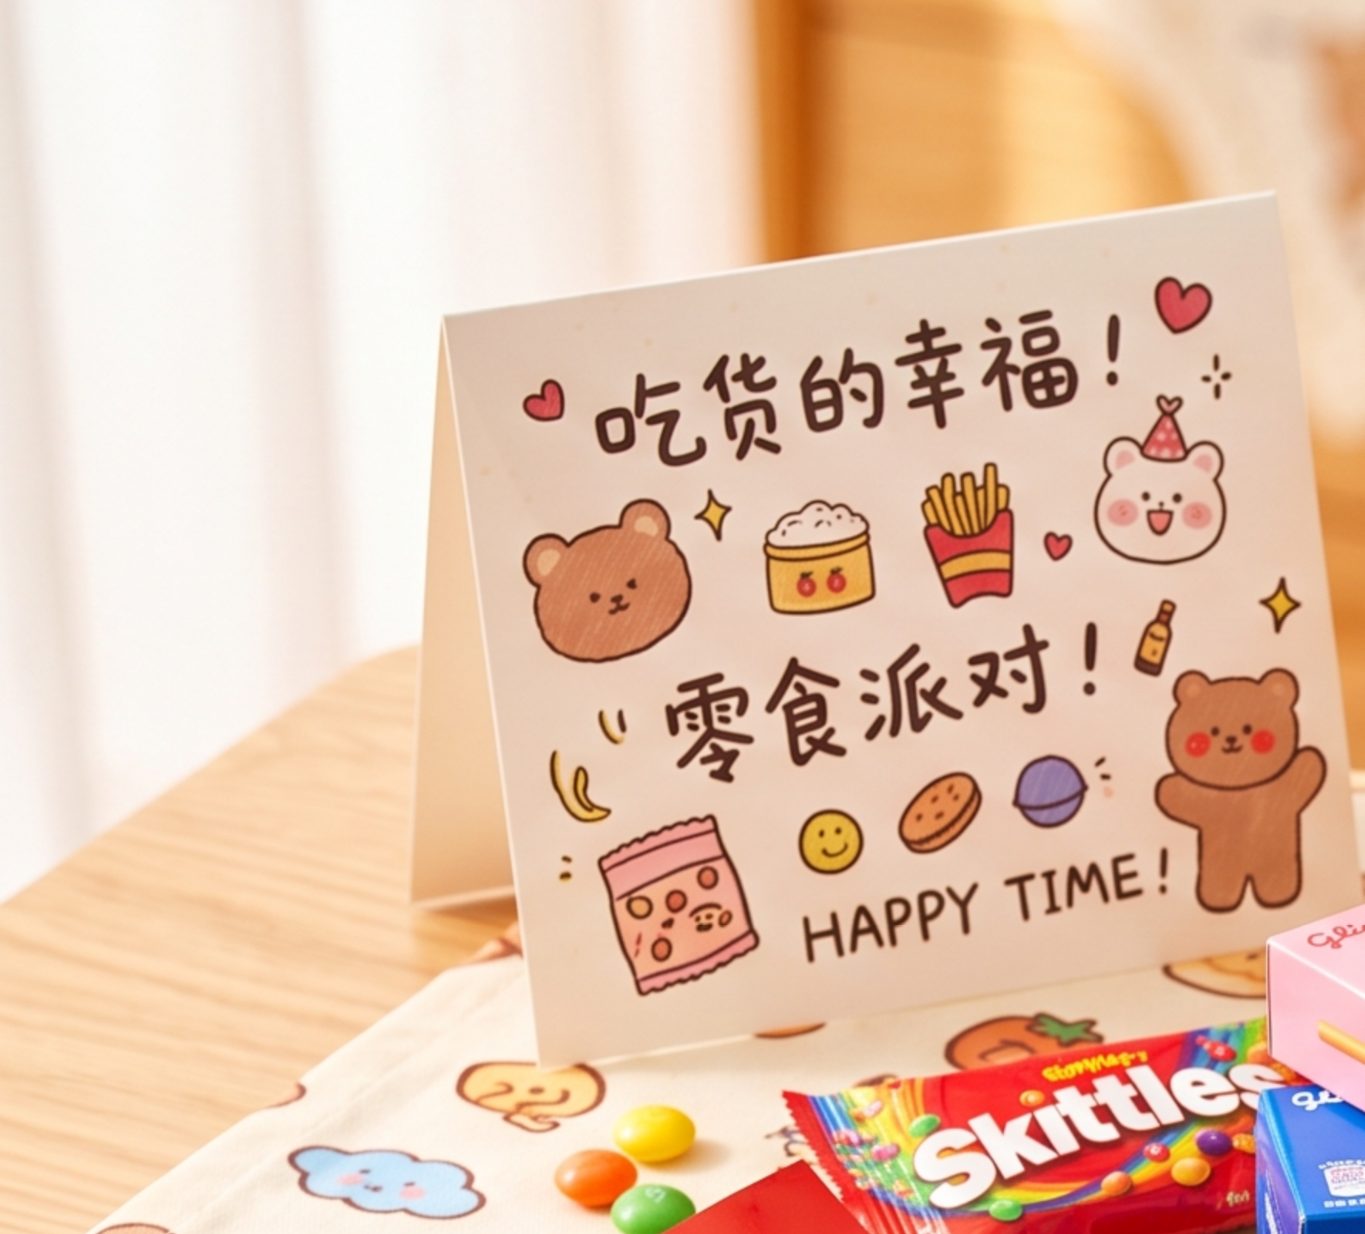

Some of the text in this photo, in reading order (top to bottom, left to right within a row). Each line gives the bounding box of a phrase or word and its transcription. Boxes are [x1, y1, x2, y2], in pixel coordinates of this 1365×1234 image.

[595, 310, 1121, 467] 吃货的幸福！
[664, 621, 1098, 783] 零食派对！
[801, 847, 1169, 964] HAPPY TIME!
[912, 1063, 1286, 1209] Skittles
